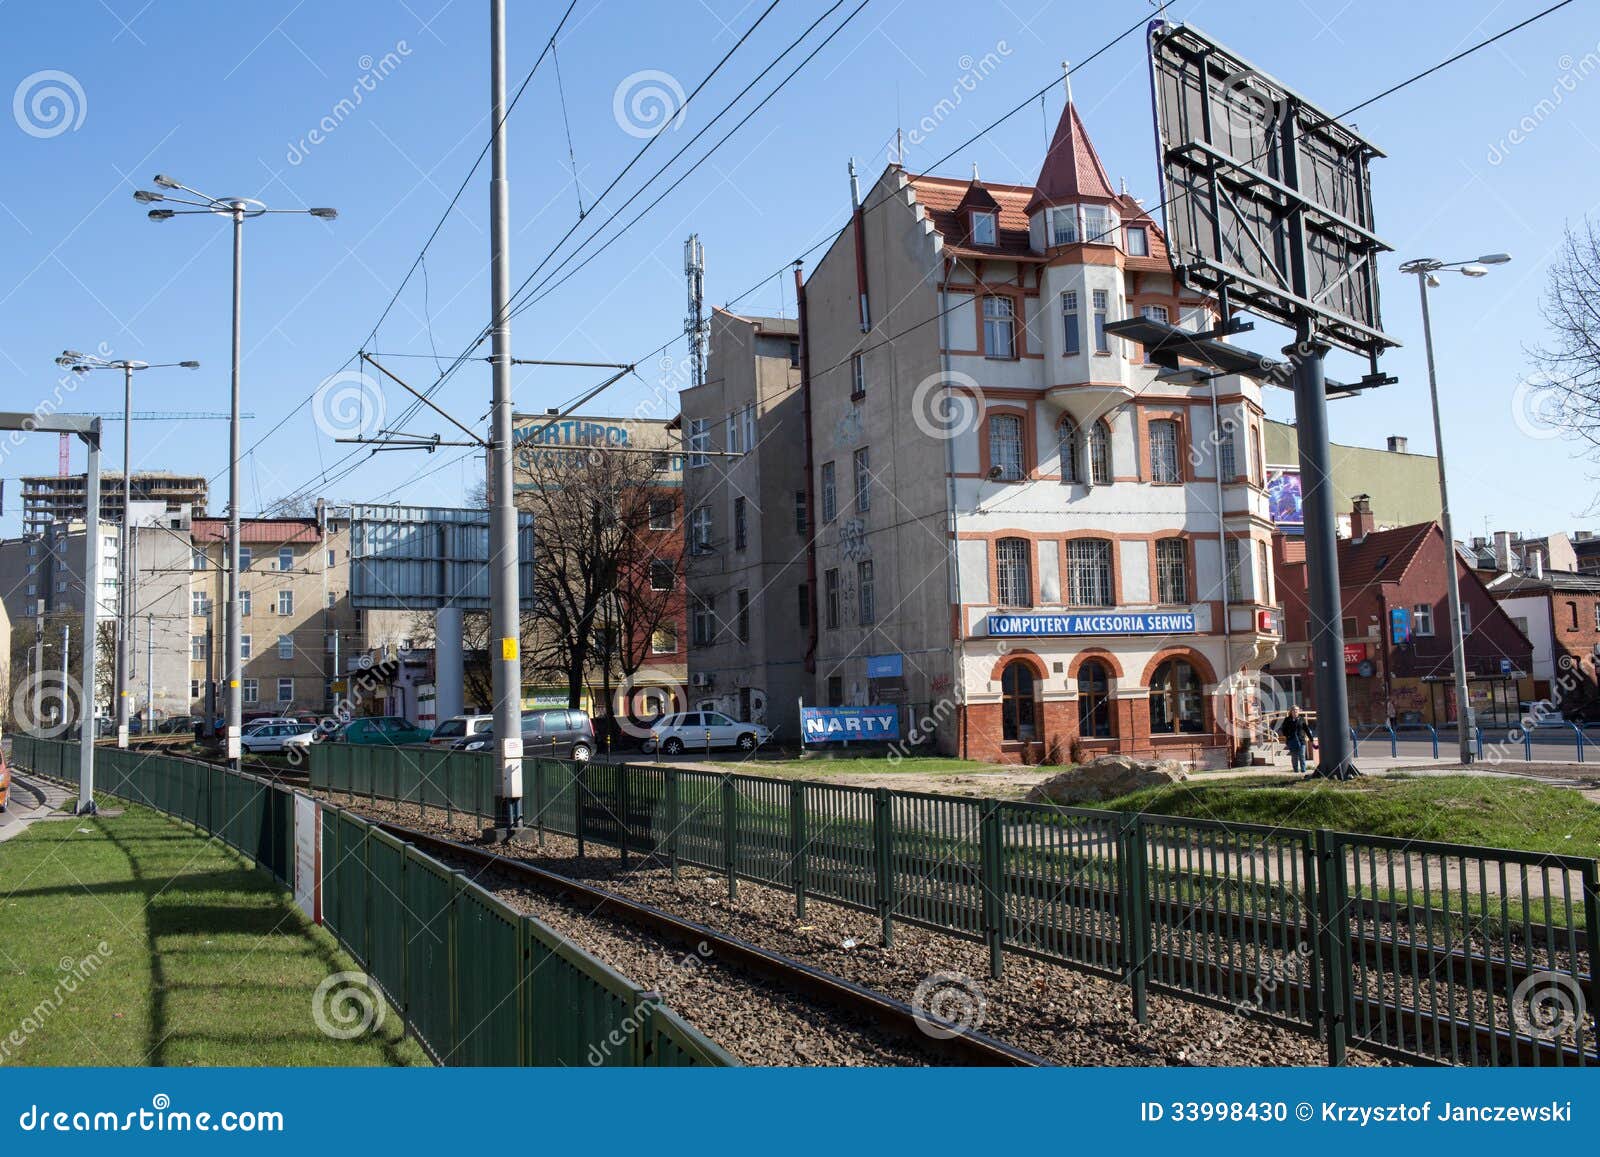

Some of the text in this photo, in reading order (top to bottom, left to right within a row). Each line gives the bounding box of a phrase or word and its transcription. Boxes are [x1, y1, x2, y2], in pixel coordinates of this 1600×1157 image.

[990, 615, 1193, 633] KOMPUTERY AKCESORIA SERWIS
[806, 716, 893, 734] NARTY
